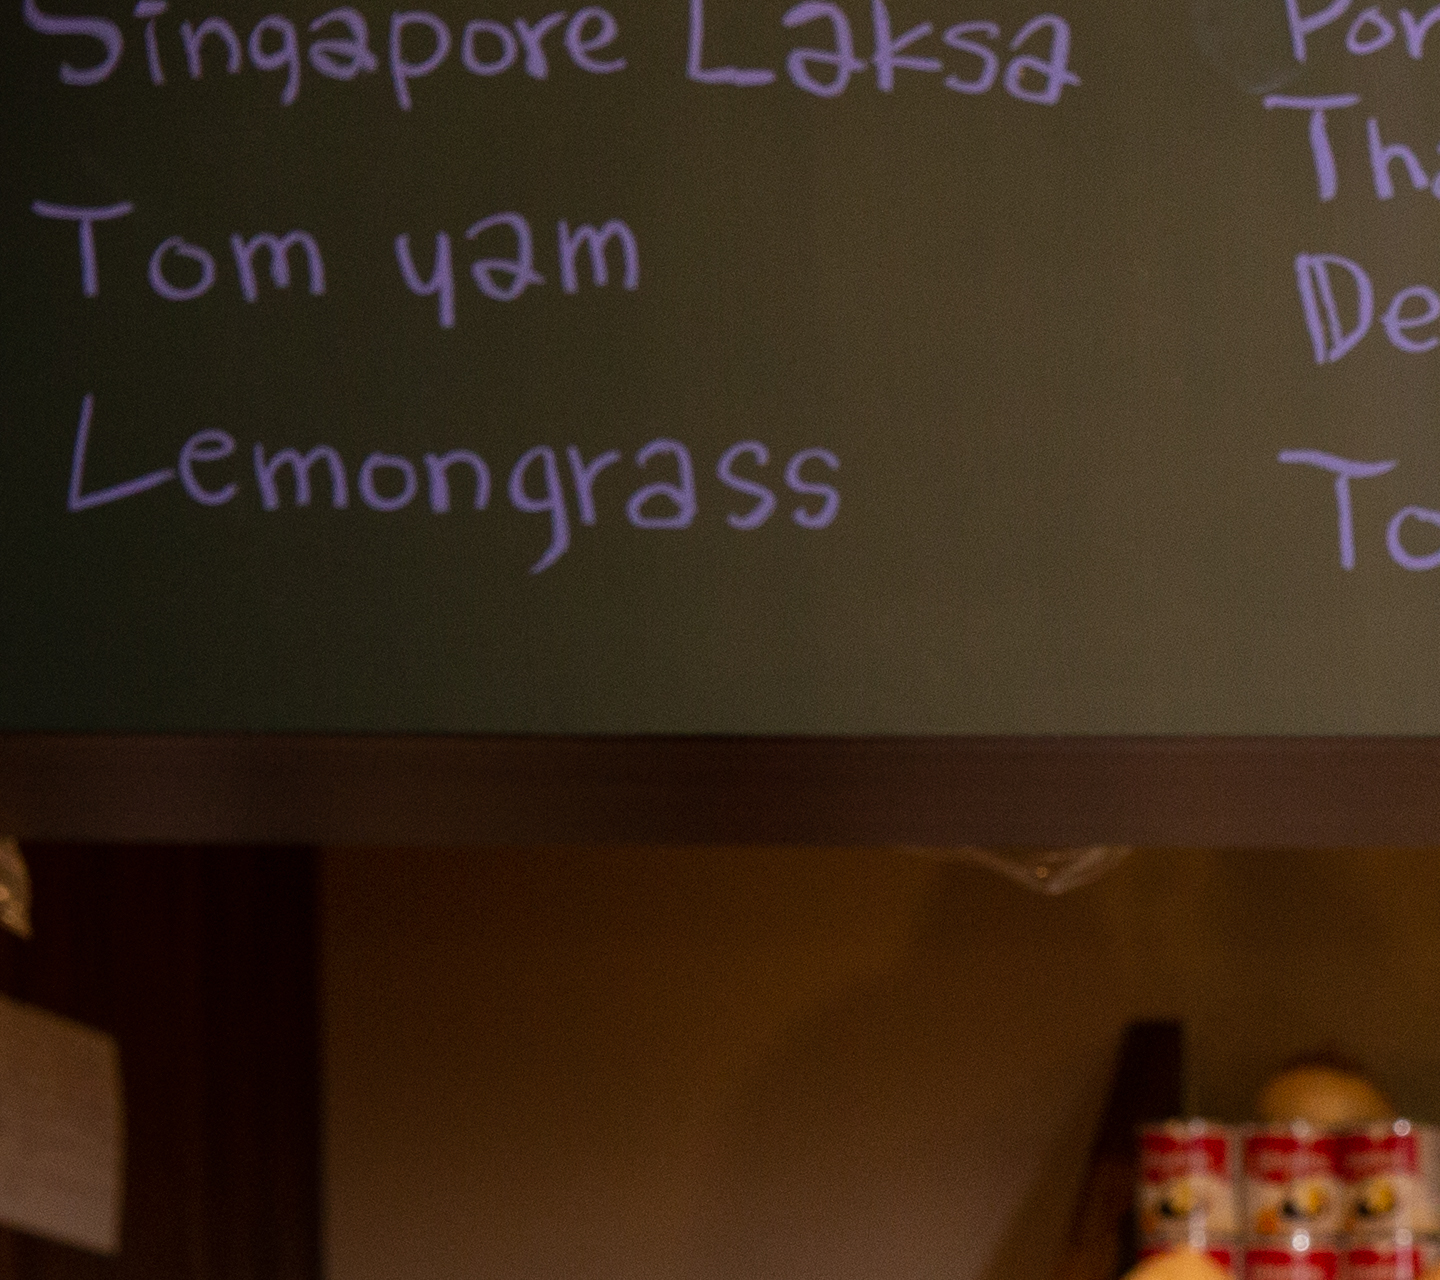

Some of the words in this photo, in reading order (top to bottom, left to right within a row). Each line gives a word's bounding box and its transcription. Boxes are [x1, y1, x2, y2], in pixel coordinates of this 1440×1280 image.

[19, 0, 627, 110] Singapore
[684, 0, 1080, 106] Laksa
[29, 198, 326, 302] Tom
[392, 210, 641, 329] yam
[64, 393, 841, 573] Lemongrass
